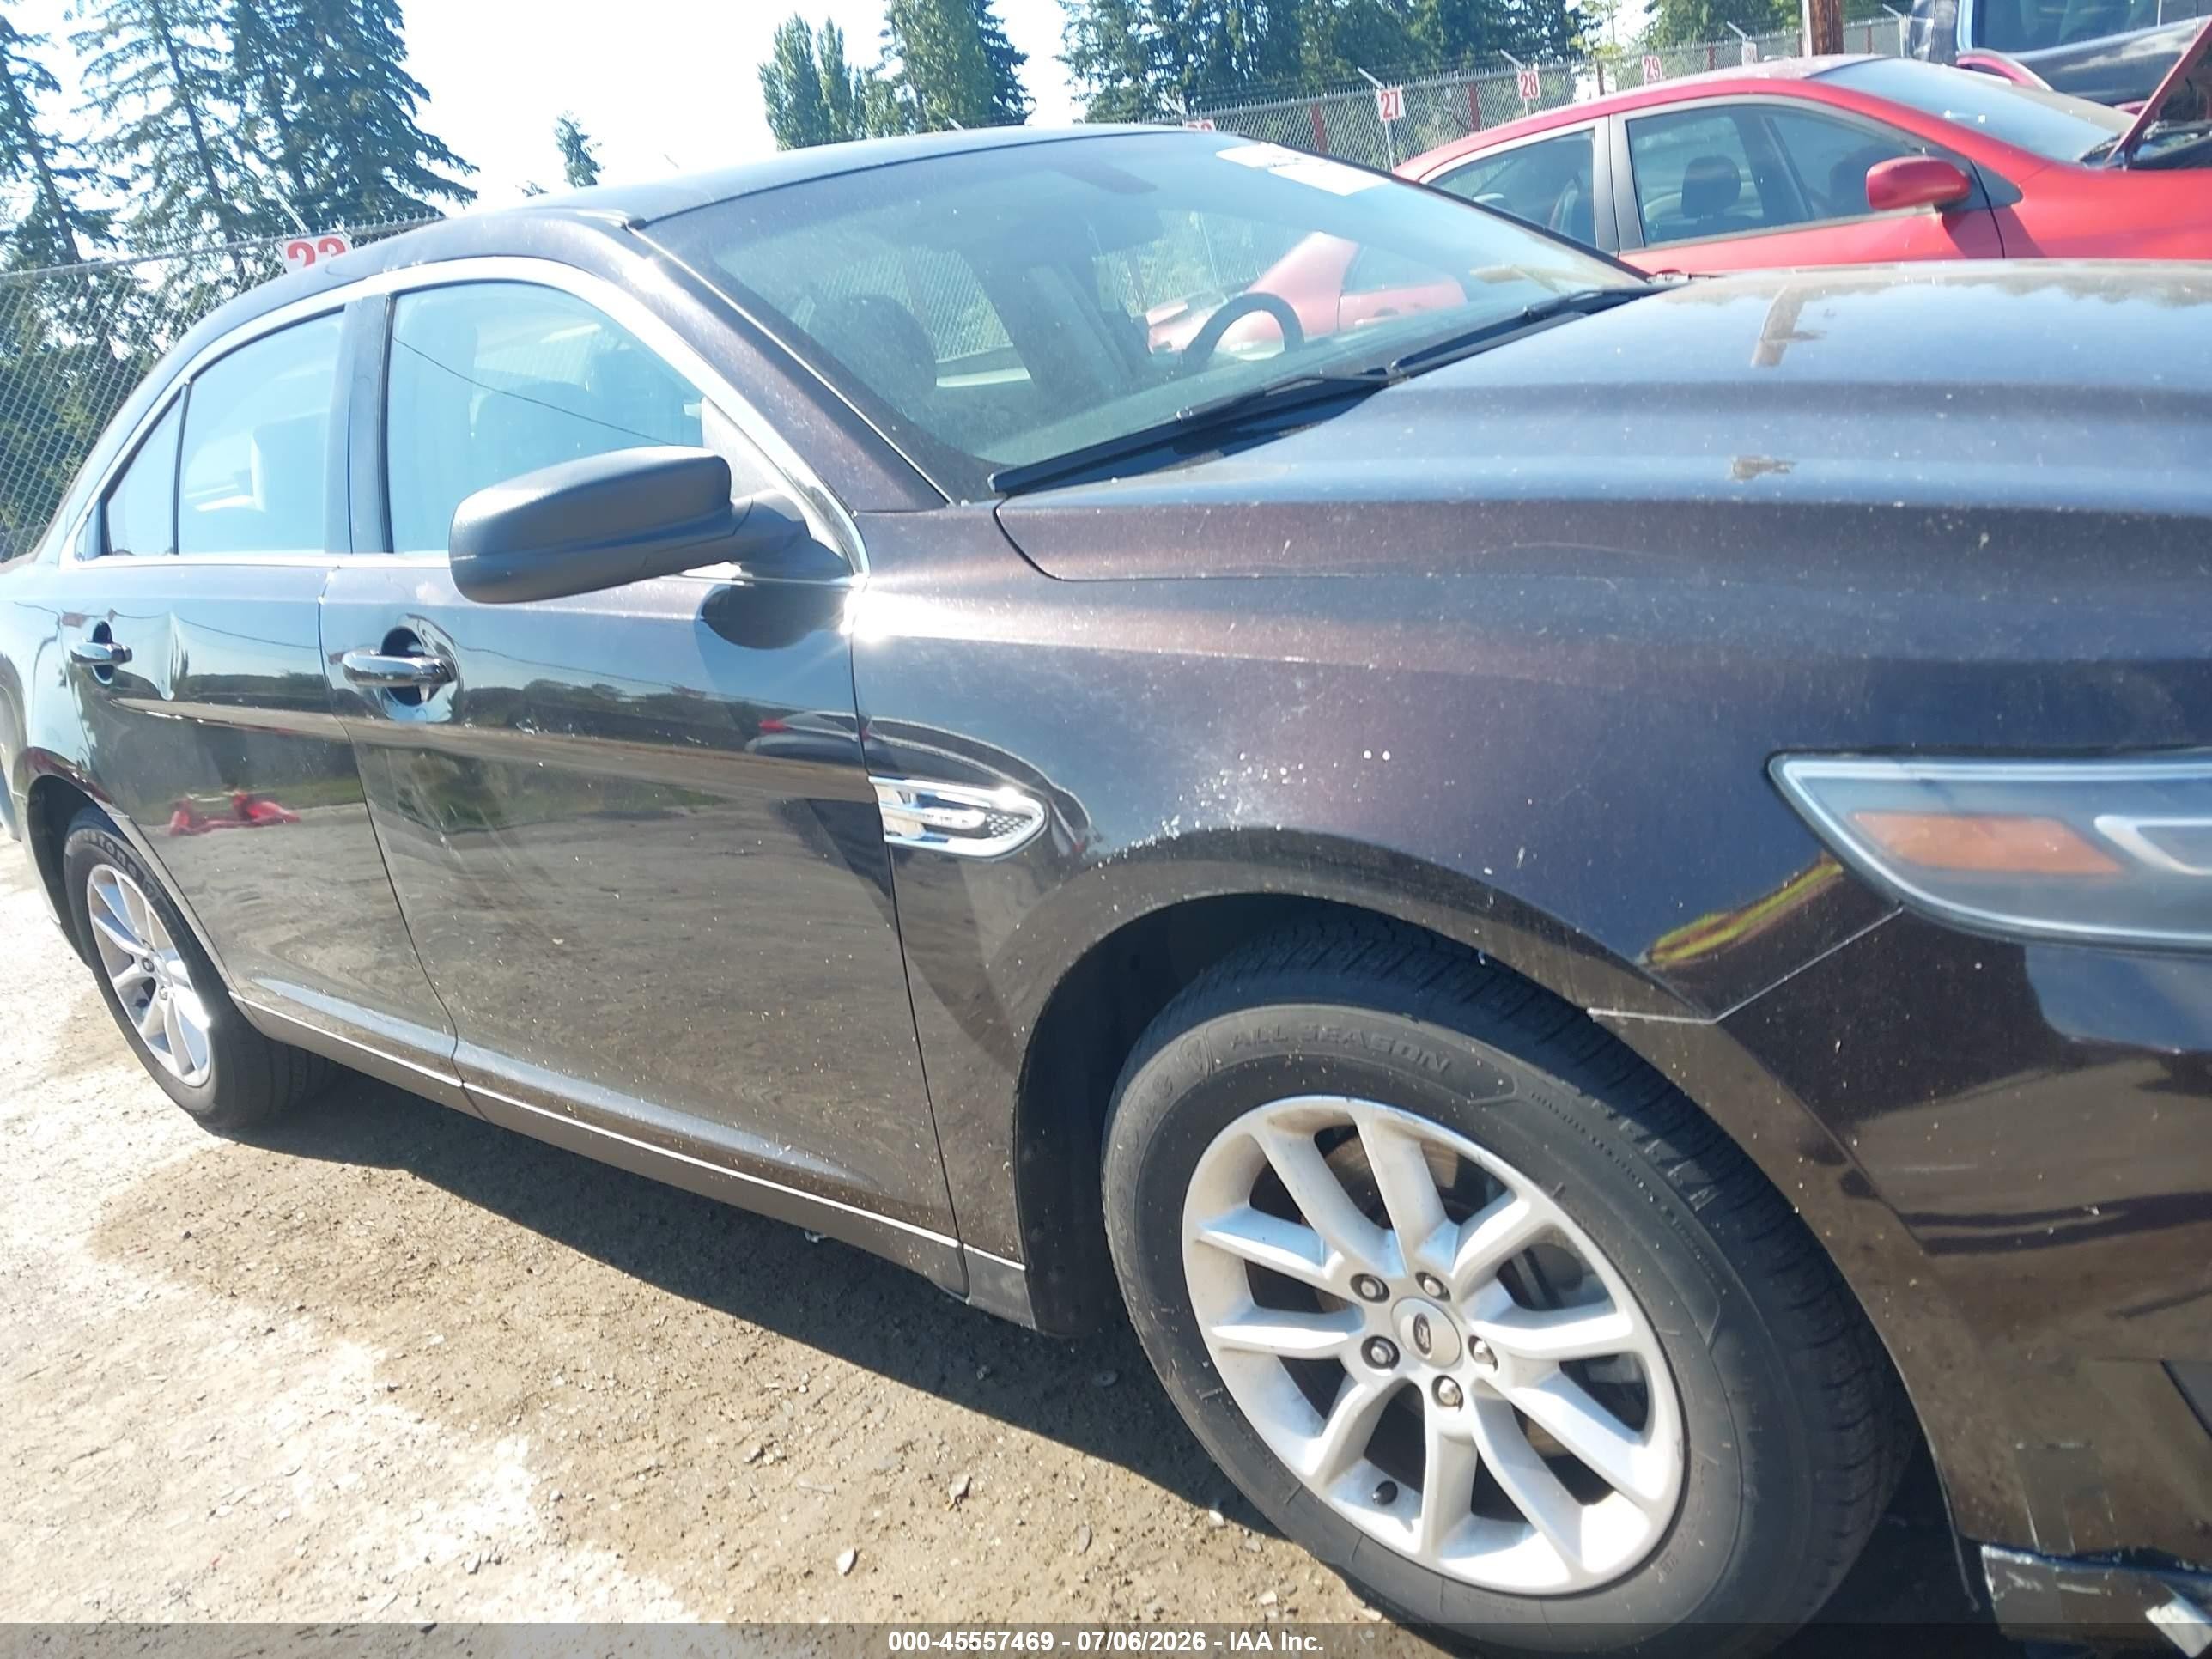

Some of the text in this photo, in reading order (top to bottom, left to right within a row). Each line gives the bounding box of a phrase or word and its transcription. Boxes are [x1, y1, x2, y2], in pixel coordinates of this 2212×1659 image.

[1644, 57, 1661, 80] 29
[1520, 73, 1538, 97] 28
[1381, 90, 1399, 118] 27
[1230, 1022, 1451, 1074] ALL SEASON
